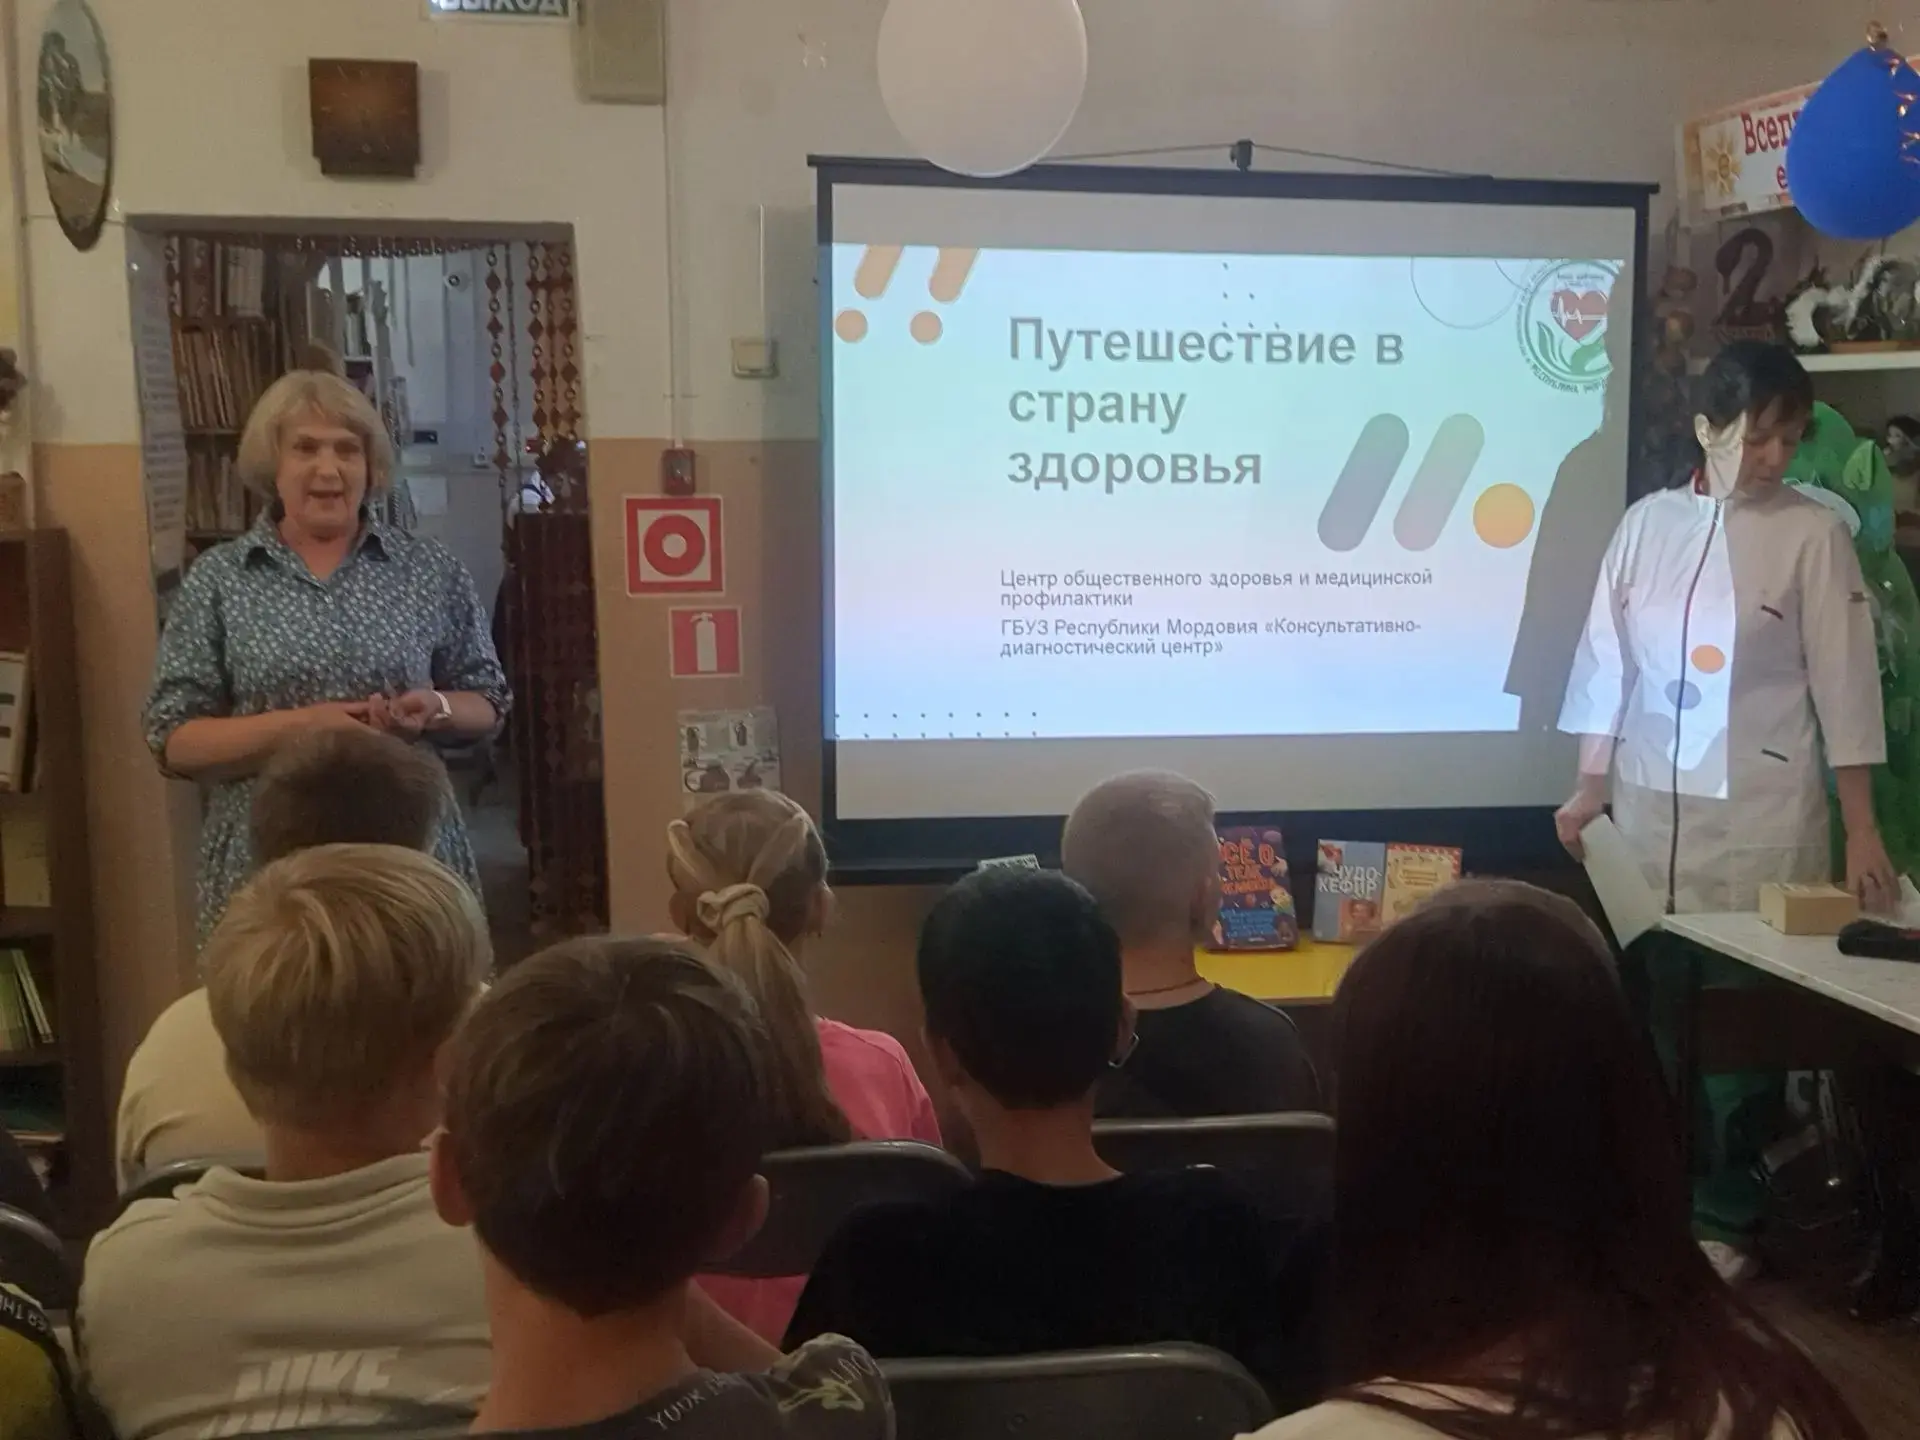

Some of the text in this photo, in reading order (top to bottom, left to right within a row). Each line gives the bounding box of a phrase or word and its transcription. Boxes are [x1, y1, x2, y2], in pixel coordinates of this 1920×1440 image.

[1740, 111, 1799, 156] Всеп
[1010, 316, 1404, 372] Путешествие в
[1008, 390, 1187, 434] страну
[1007, 452, 1261, 495] здоровья
[1000, 568, 1433, 588] Центр общественного здоровья и медицинской
[1000, 590, 1133, 610] профилактики
[1001, 617, 1422, 641] ГБУЗ Республики Мордовия «Консультативно-
[1000, 638, 1224, 659] диагностический центр»
